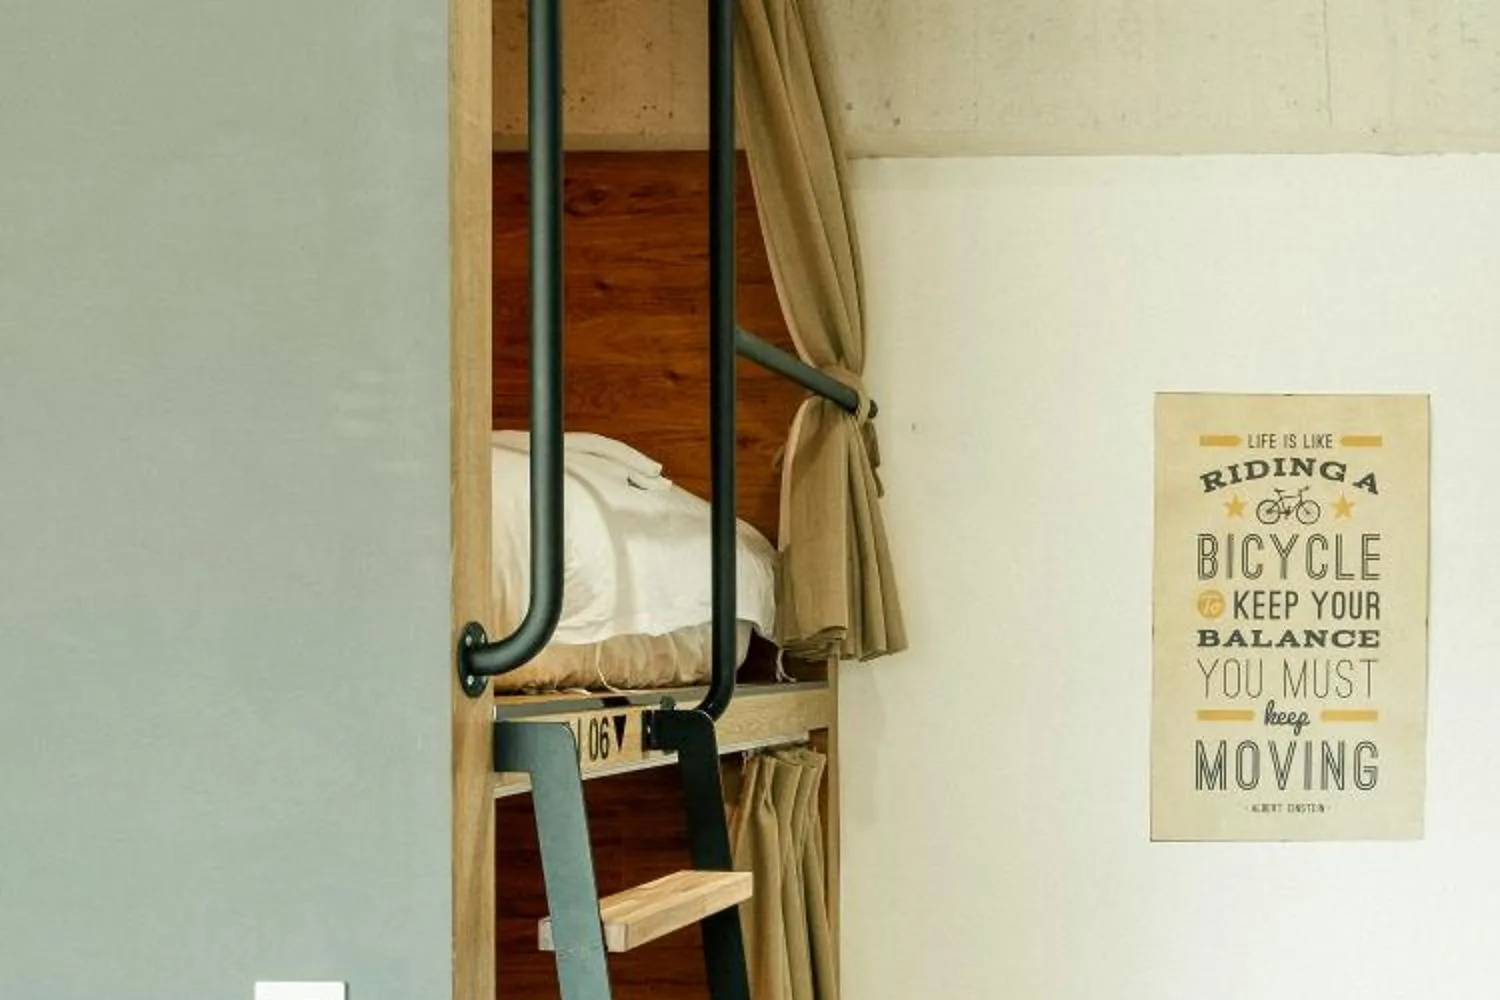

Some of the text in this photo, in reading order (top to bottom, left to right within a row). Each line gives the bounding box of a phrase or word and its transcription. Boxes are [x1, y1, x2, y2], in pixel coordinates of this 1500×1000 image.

[1248, 434, 1333, 449] LIFE IS LIKE
[1200, 457, 1379, 495] RIDING A
[1197, 533, 1381, 581] BICYCLE
[1233, 590, 1299, 620] KEEP
[1311, 590, 1380, 620] YOUR
[1197, 629, 1380, 648] BALANCE
[1197, 658, 1379, 699] YOU MUST
[1264, 699, 1311, 736] keep
[588, 717, 610, 761] 06
[1195, 739, 1379, 791] MOVING
